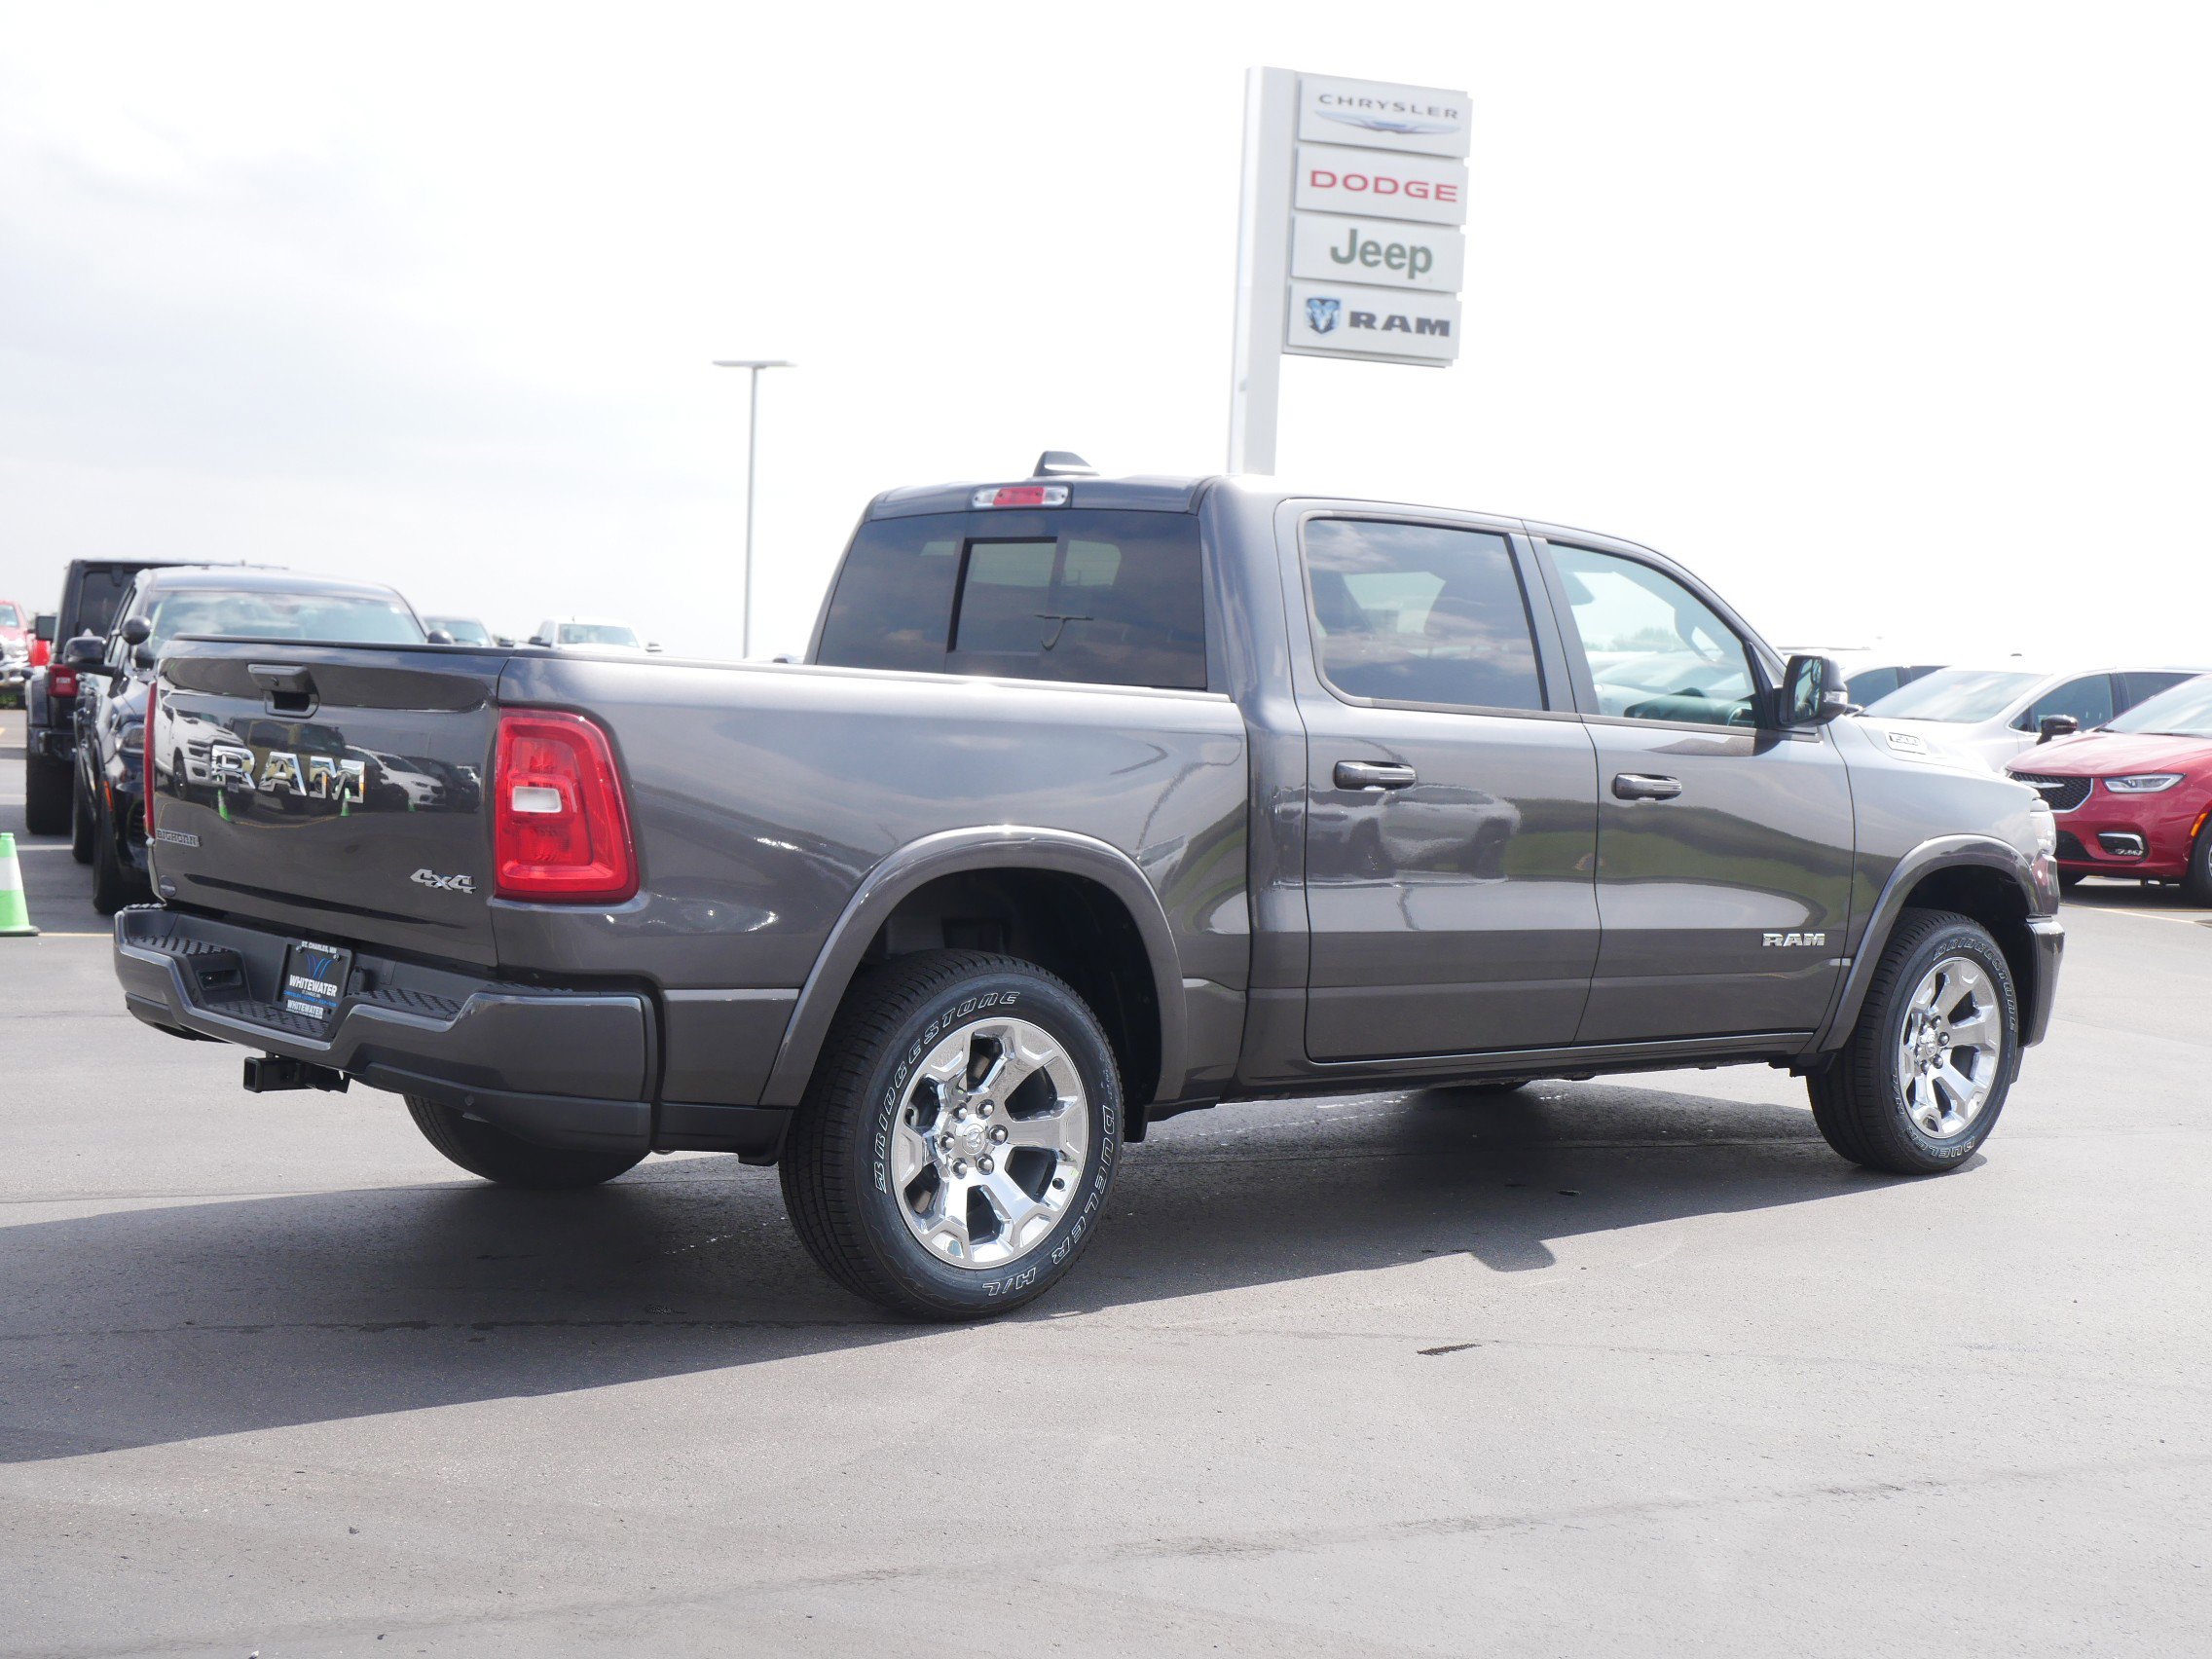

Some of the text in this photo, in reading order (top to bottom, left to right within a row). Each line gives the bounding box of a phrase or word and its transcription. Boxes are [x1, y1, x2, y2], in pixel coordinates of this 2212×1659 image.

[1318, 93, 1458, 119] CHRYSLER
[1309, 170, 1457, 203] DODGE
[1330, 228, 1433, 279] Jeep
[1348, 310, 1451, 337] RAM
[211, 744, 365, 804] RAM
[1762, 933, 1825, 946] RAM
[289, 975, 337, 997] WHITEWATER
[1933, 938, 2016, 1033] BRIDGESTONE
[287, 999, 323, 1016] WHITEWATER
[875, 991, 1020, 1194] BRIDGESTONE
[982, 1105, 1116, 1297] DUELER H/L
